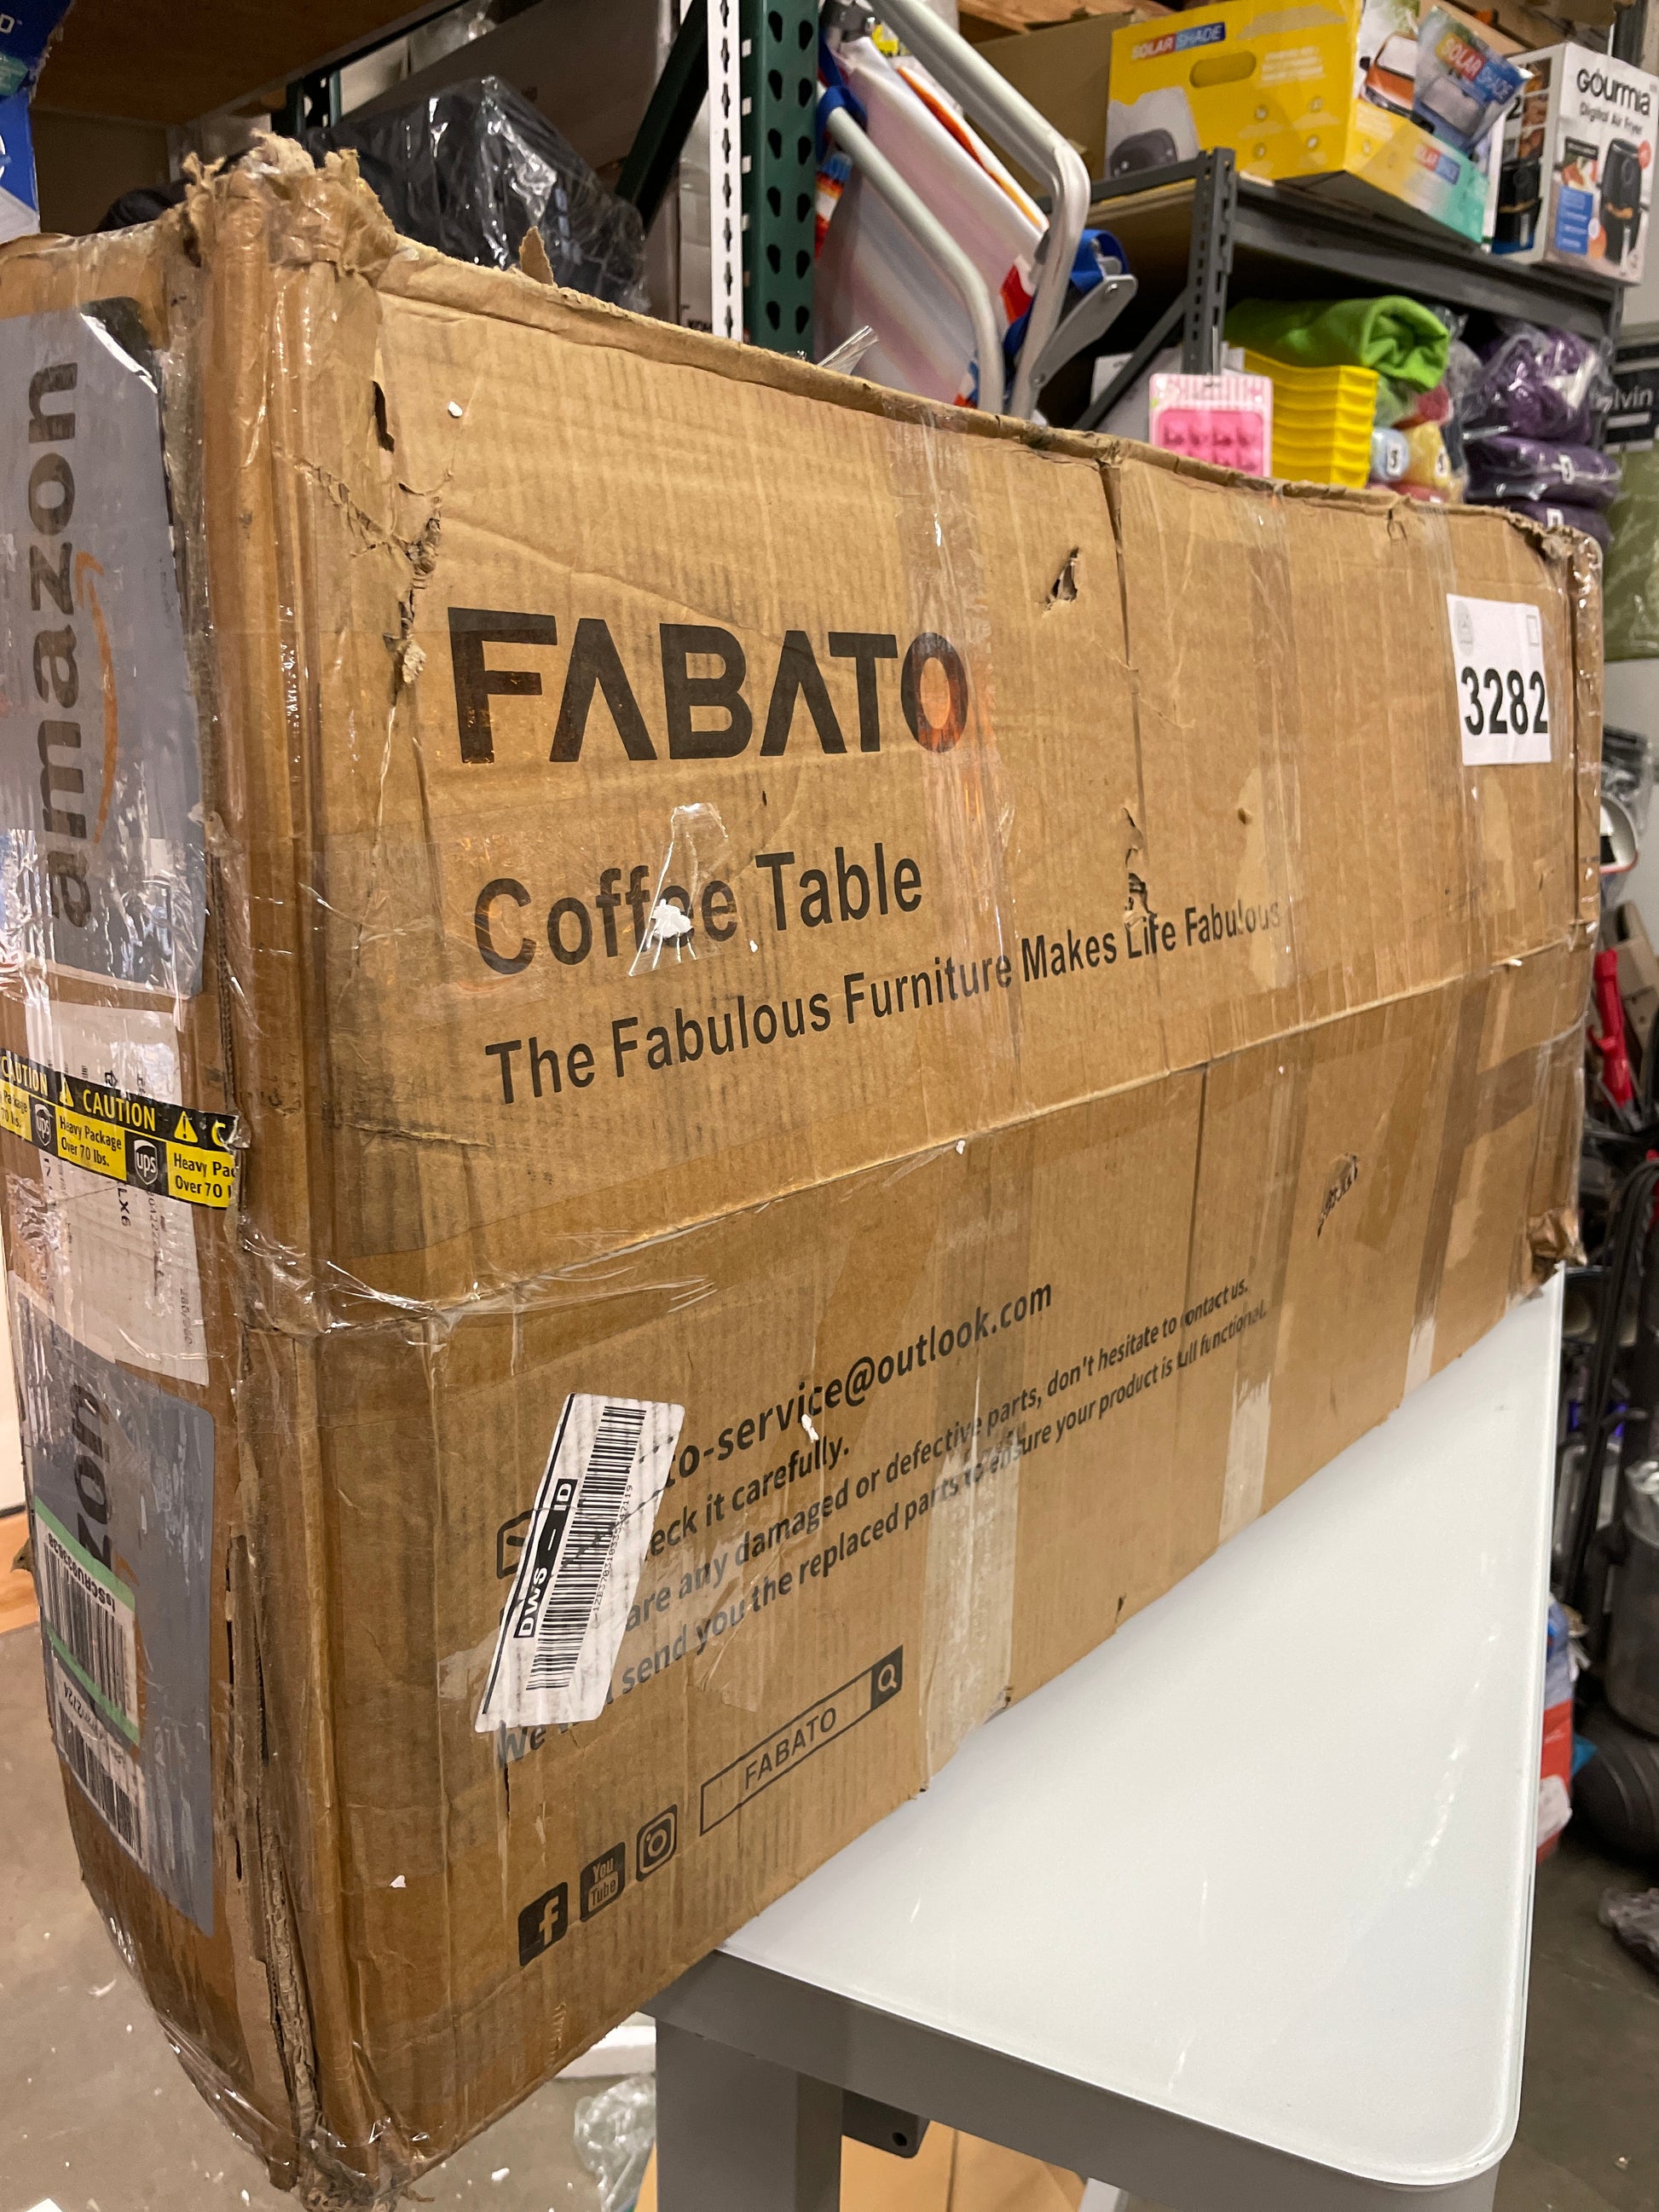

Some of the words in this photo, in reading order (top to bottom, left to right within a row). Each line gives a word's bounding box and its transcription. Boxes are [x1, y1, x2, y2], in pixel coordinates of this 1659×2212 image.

[1131, 36, 1175, 61] SOLAR
[1176, 24, 1223, 50] SHADE
[1576, 68, 1650, 116] Gourmia
[28, 361, 91, 927] amazon
[448, 607, 968, 764] FABATO
[1460, 666, 1548, 736] 3282
[755, 842, 922, 932] Table
[485, 1037, 595, 1105] The
[611, 996, 831, 1077] Fabulous
[843, 955, 1013, 1024] Furniture
[1021, 929, 1118, 982] Makes
[1126, 912, 1176, 959] Life
[1185, 897, 1282, 947] Fabulous
[1, 1055, 49, 1096] CAUTION
[38, 1117, 51, 1139] ups
[60, 1115, 83, 1141] Heavy
[84, 1125, 123, 1152] Package
[83, 1089, 156, 1132] CAUTION
[61, 1136, 78, 1156] Over
[80, 1145, 91, 1160] 70
[94, 1149, 110, 1167] lbs.
[136, 1152, 156, 1177] ups
[173, 1152, 208, 1178] Heavy
[175, 1175, 203, 1194] Over
[205, 1182, 223, 1198] 70
[664, 1283, 1052, 1489] to-service@outlook.com
[626, 1583, 672, 1632] are
[678, 1551, 730, 1596] any
[735, 1481, 849, 1567] damaged
[856, 1467, 882, 1499] or
[886, 1417, 982, 1485] defective
[986, 1387, 1042, 1437] parts,
[1047, 1355, 1094, 1396] don't
[1097, 1325, 1159, 1372] hesitate
[1162, 1314, 1177, 1337] to
[1230, 1278, 1249, 1301] us.
[649, 1505, 697, 1557] eck
[706, 1492, 725, 1528] it
[731, 1435, 850, 1511] carefully.
[621, 1622, 687, 1695] send
[695, 1597, 745, 1655] you
[751, 1574, 793, 1614] the
[798, 1501, 899, 1585] replaced
[904, 1476, 958, 1531] parts
[963, 1462, 984, 1487] to
[1055, 1399, 1095, 1443] your
[1099, 1364, 1159, 1419] product
[1161, 1355, 1173, 1379] is
[518, 1566, 548, 1637] DWS
[553, 1481, 573, 1512] ID
[744, 1707, 838, 1790] FABATO
[590, 1876, 617, 1907] Tube
[592, 1856, 615, 1884] You
